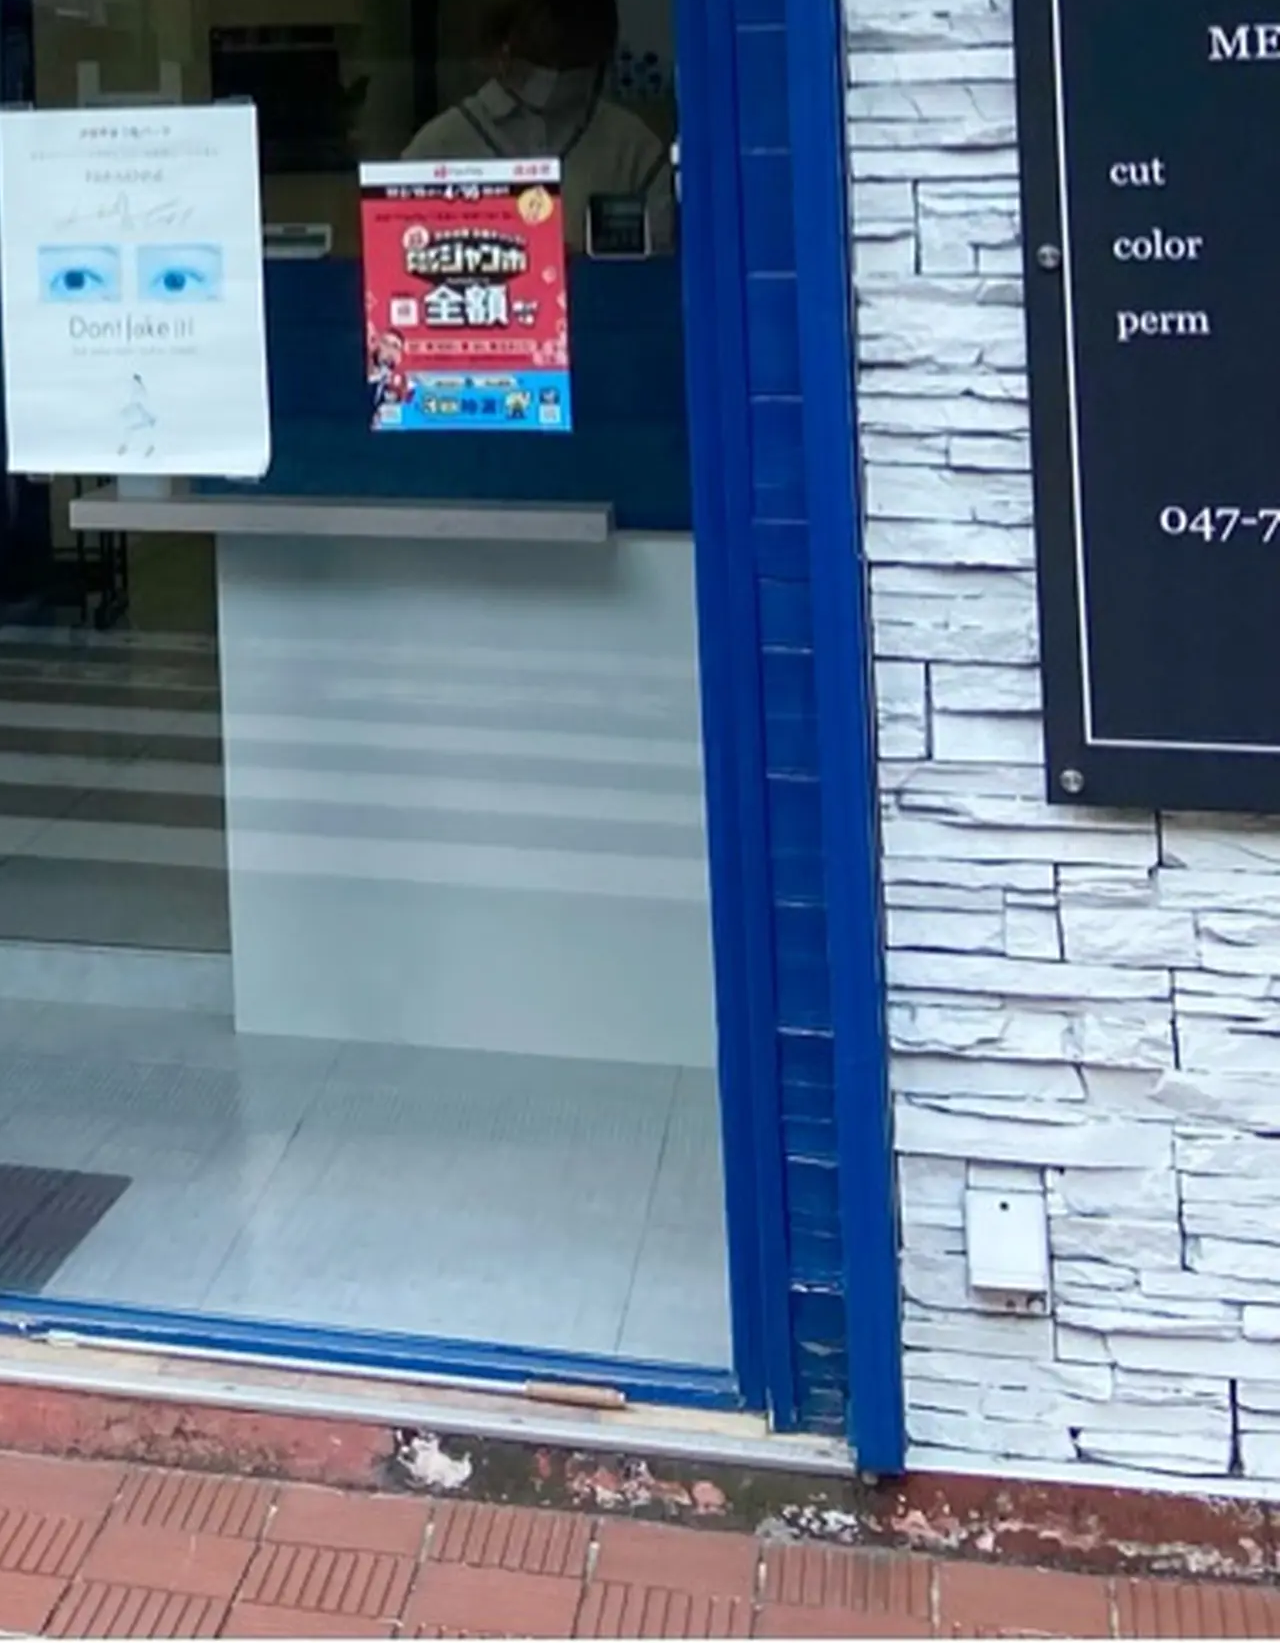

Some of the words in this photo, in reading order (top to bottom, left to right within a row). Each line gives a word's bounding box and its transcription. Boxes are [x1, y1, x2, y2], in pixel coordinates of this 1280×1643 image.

[1208, 23, 1280, 61] ME
[1109, 157, 1166, 186] cut
[1113, 227, 1204, 260] color
[424, 284, 509, 326] 全額
[1116, 310, 1211, 343] perm
[1159, 505, 1280, 543] 047-7
